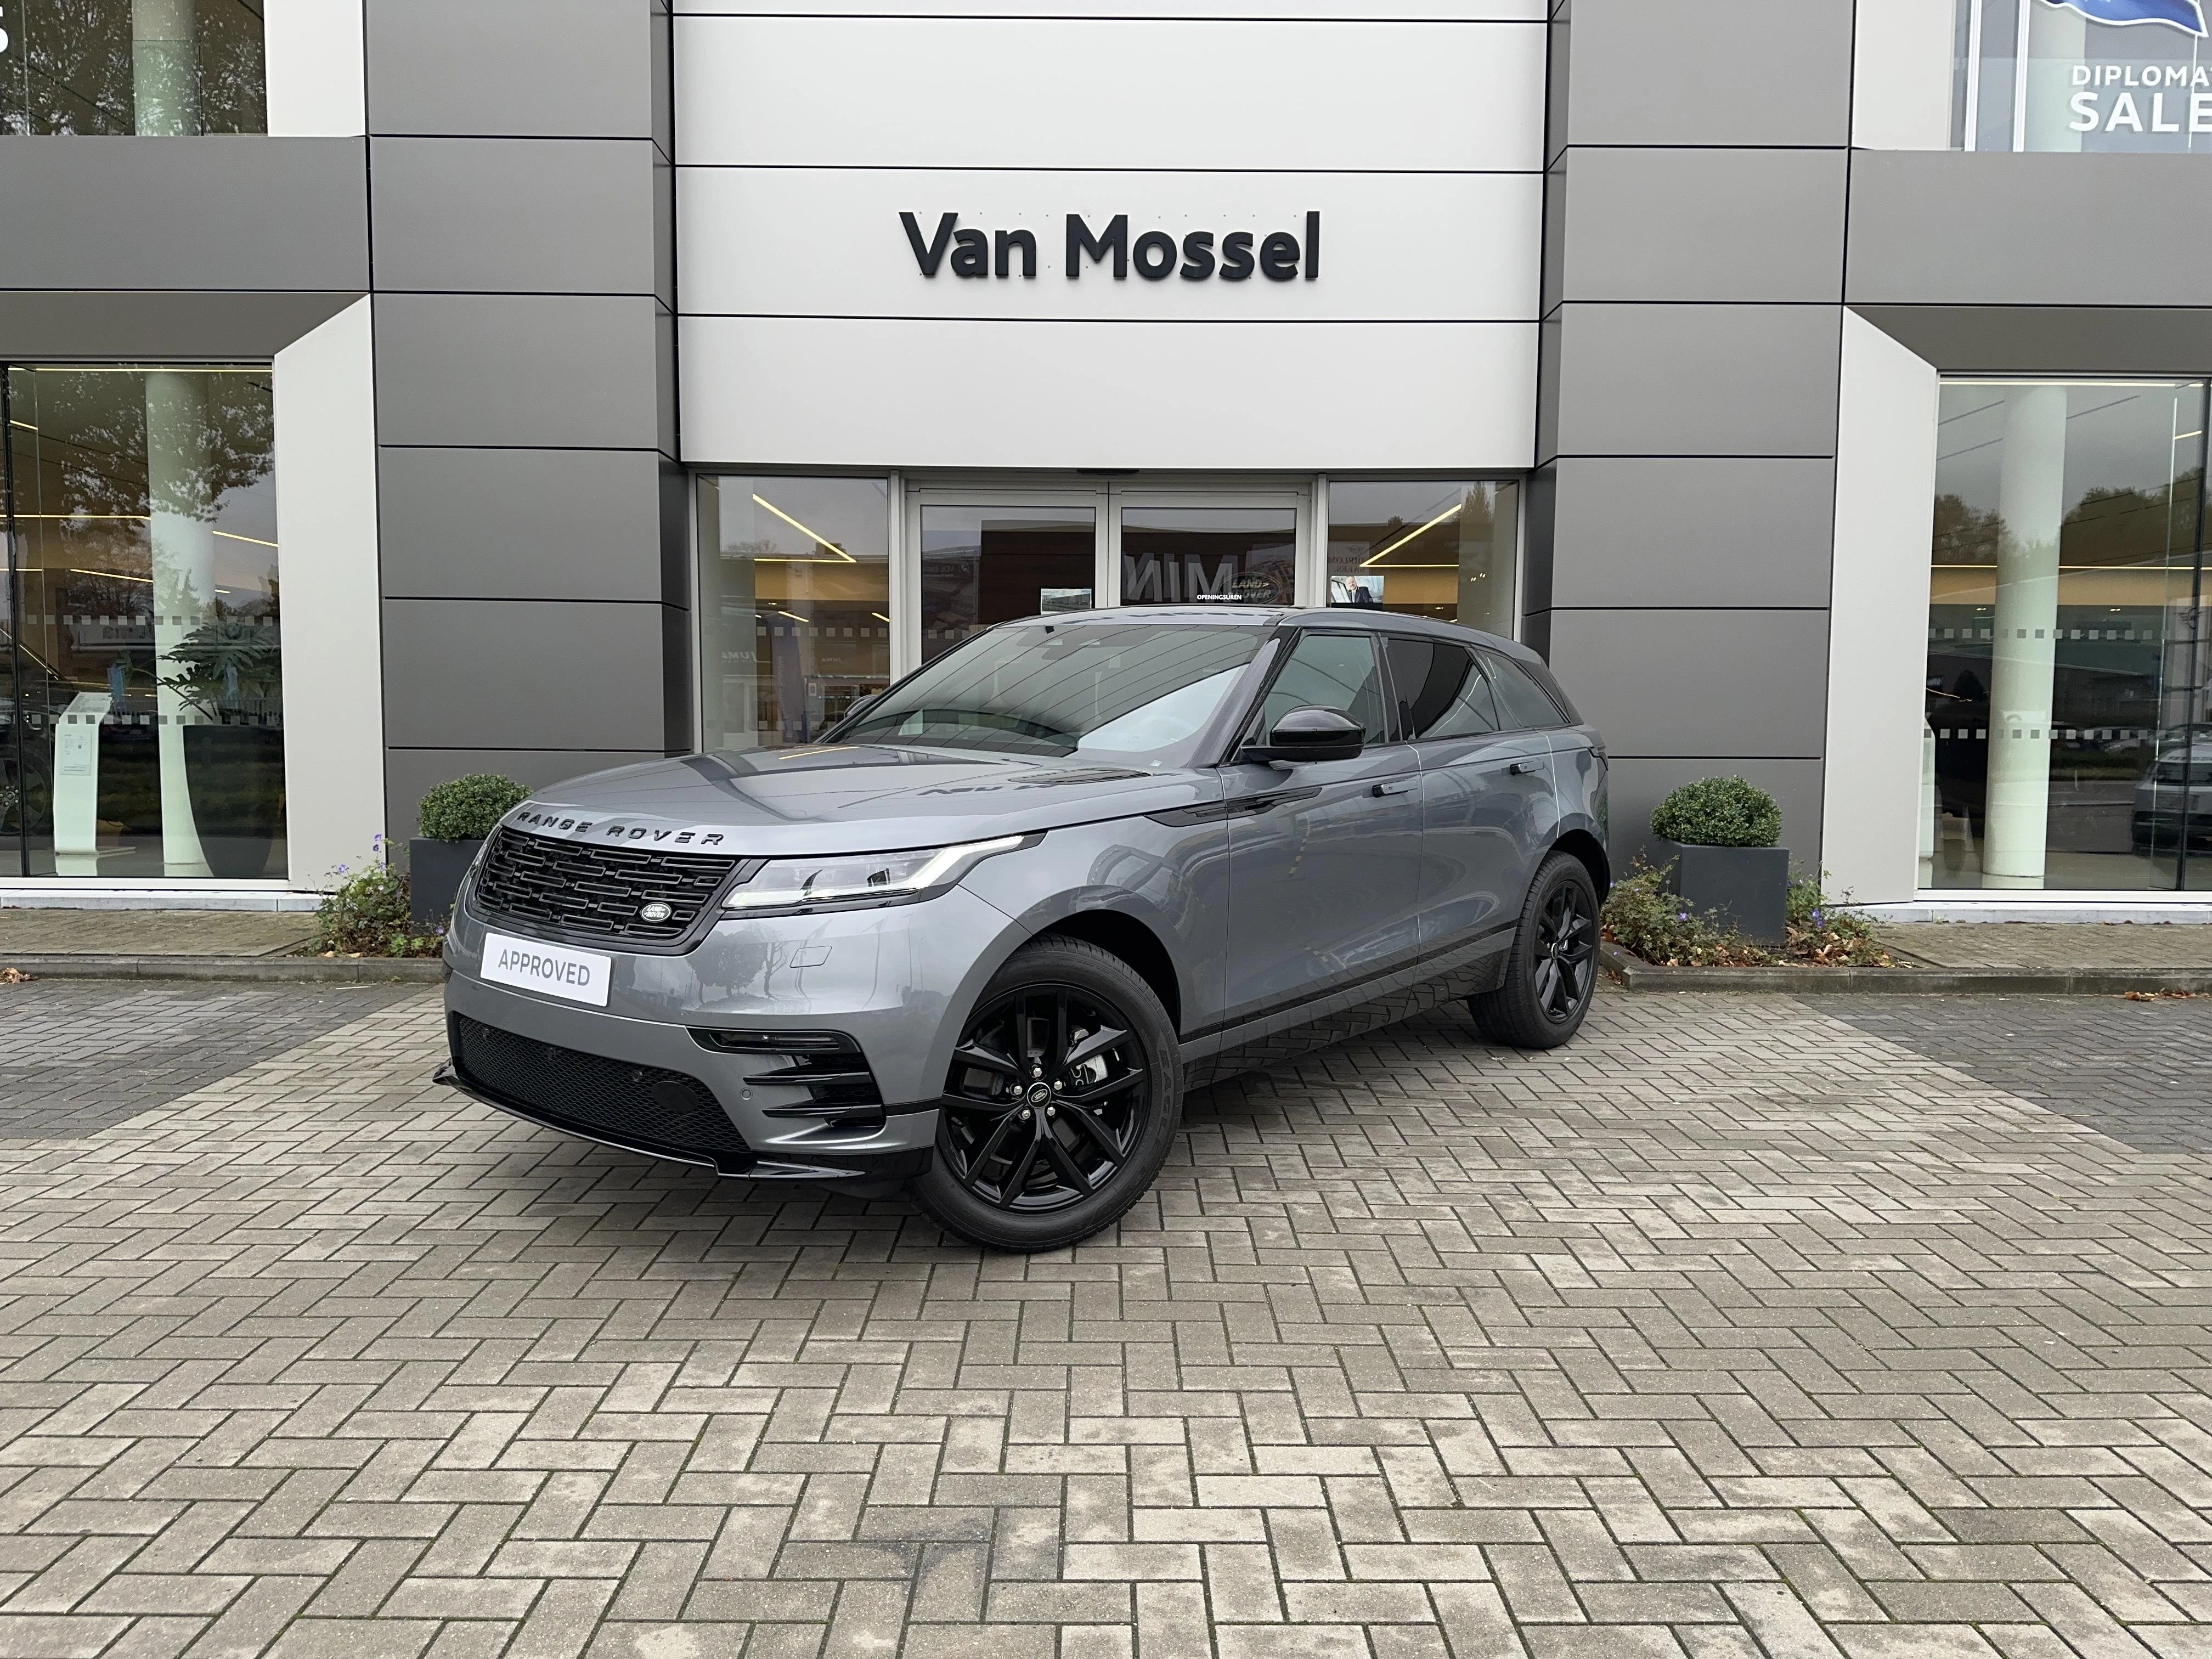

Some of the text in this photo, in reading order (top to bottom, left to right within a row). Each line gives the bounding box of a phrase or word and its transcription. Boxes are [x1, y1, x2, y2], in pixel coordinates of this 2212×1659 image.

[2072, 65, 2212, 86] DIPLOMA
[2069, 91, 2212, 132] SALE
[898, 211, 1321, 280] Van Mossel
[1232, 579, 1262, 589] LAND
[517, 812, 724, 845] RANGE ROVER
[498, 949, 590, 986] APPROVED
